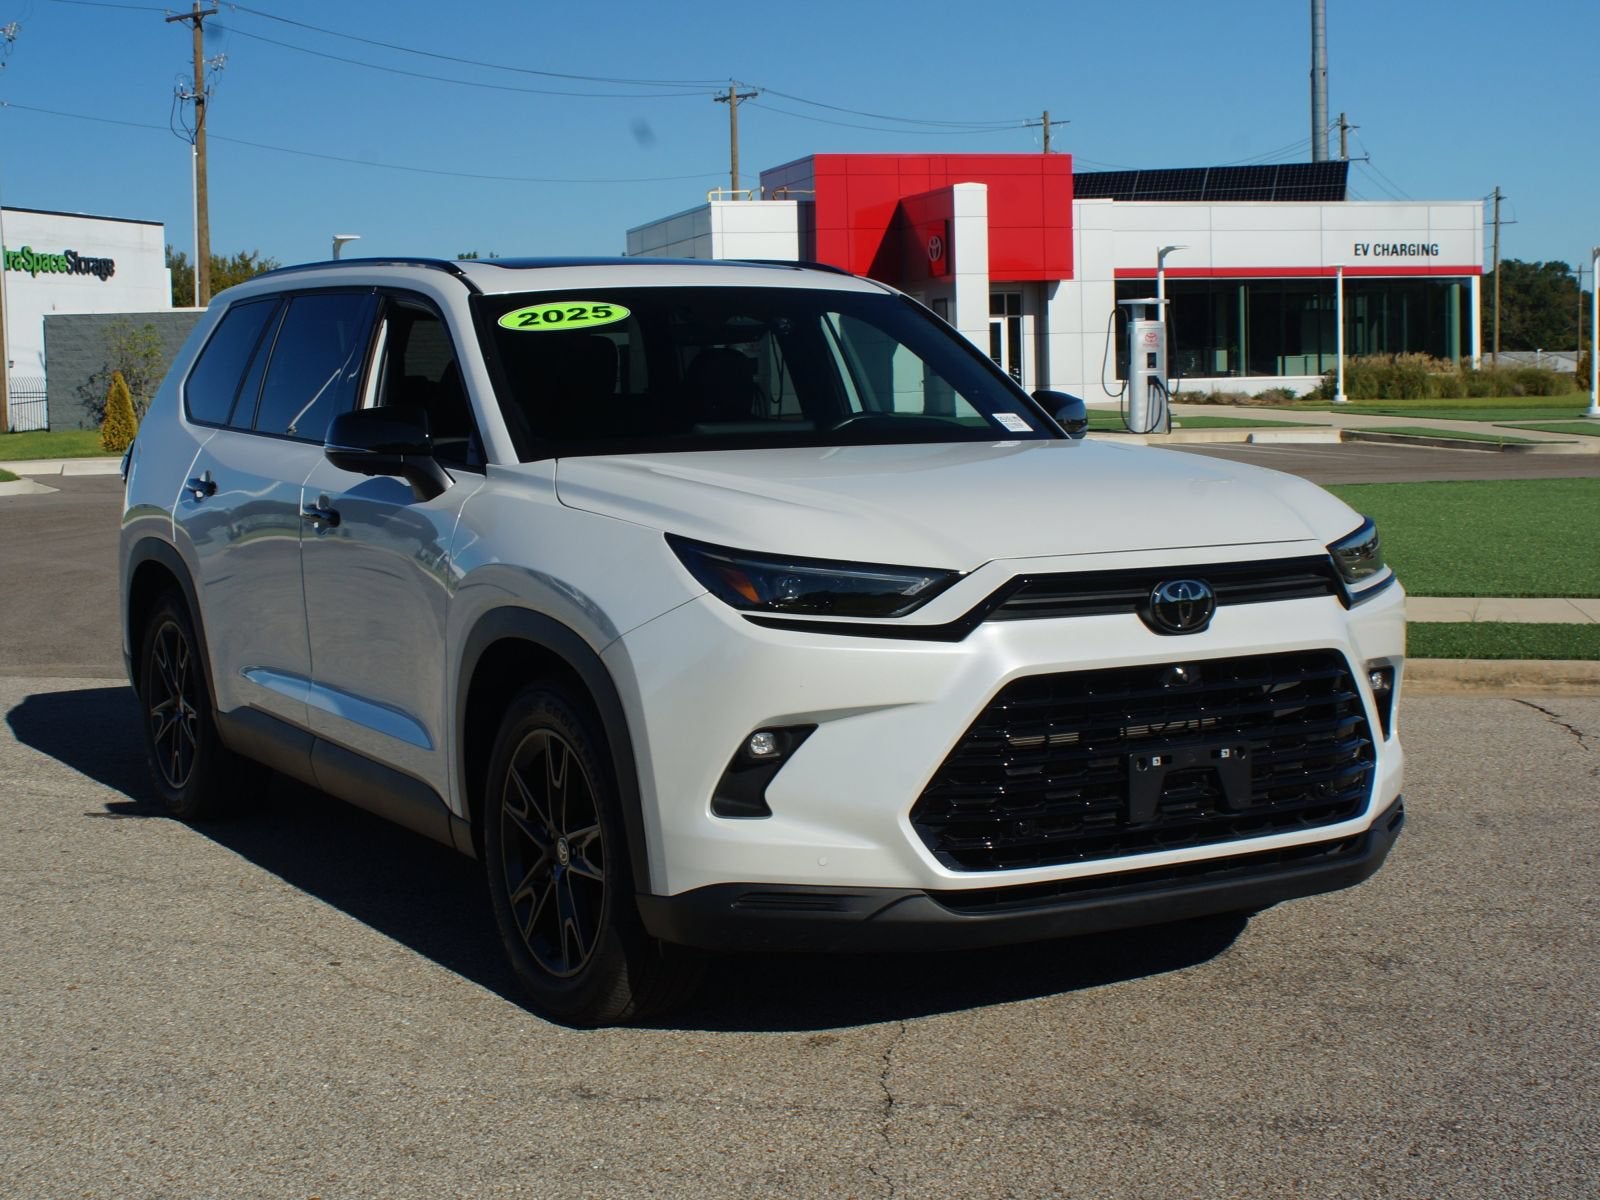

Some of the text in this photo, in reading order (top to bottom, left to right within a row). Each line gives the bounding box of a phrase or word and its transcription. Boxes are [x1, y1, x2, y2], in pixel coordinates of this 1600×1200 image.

[1354, 243, 1439, 256] EV CHARGING
[517, 305, 613, 327] 2025
